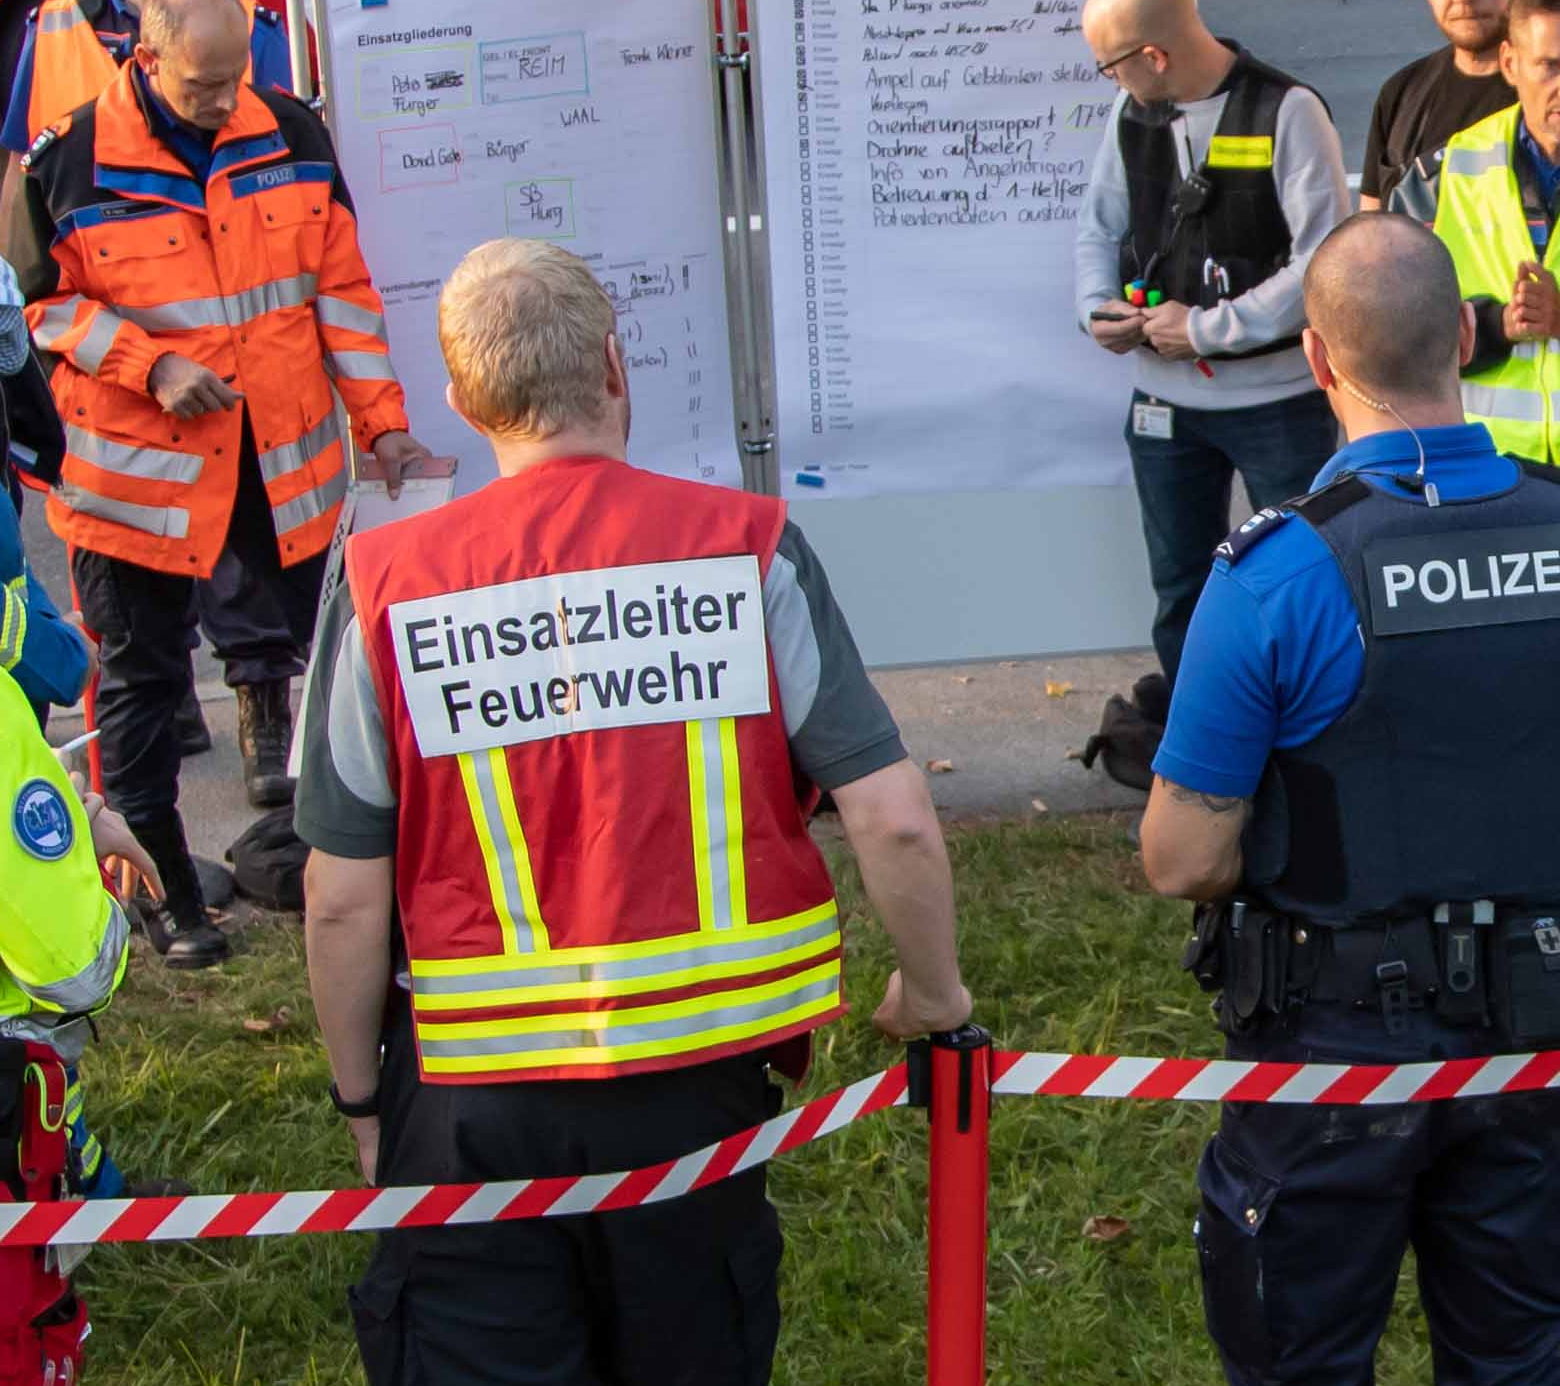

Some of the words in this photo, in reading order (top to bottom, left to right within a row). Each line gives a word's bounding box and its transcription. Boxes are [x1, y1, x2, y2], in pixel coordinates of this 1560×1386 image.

[357, 23, 473, 48] Einsatzgliederung
[865, 68, 914, 96] Ampel
[920, 71, 951, 95] auf
[867, 141, 929, 160] Drohne
[256, 166, 296, 189] POLIZ
[869, 161, 904, 181] Info
[920, 168, 949, 180] von
[405, 579, 748, 675] Einsatzleiter
[440, 649, 729, 736] Feuerwehr
